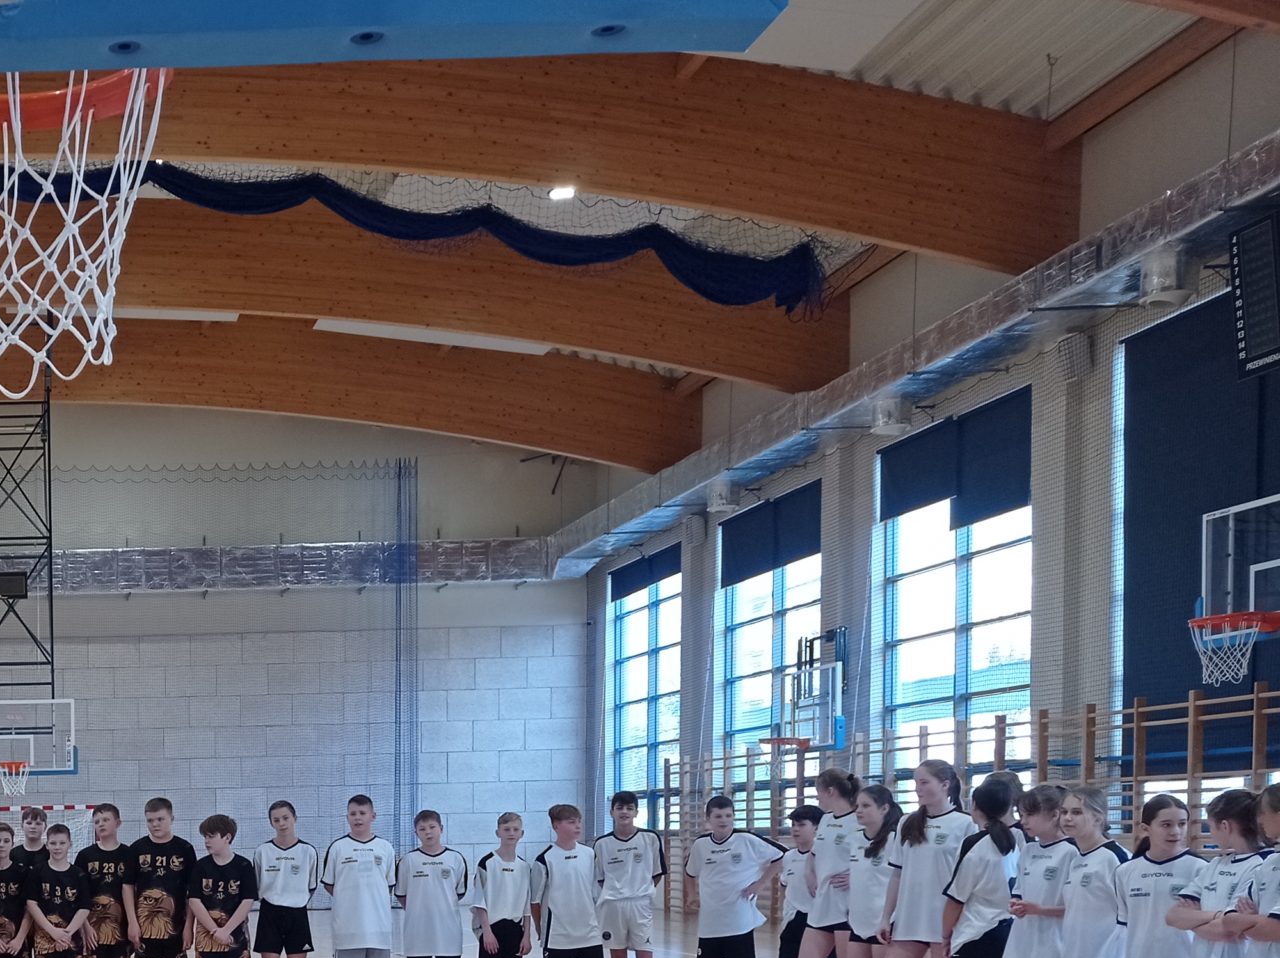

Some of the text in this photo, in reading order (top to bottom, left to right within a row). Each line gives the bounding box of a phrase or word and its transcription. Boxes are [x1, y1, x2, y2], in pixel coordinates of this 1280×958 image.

[155, 856, 167, 866] 21
[102, 862, 115, 873] 23
[55, 886, 61, 896] 3
[218, 881, 224, 892] 2
